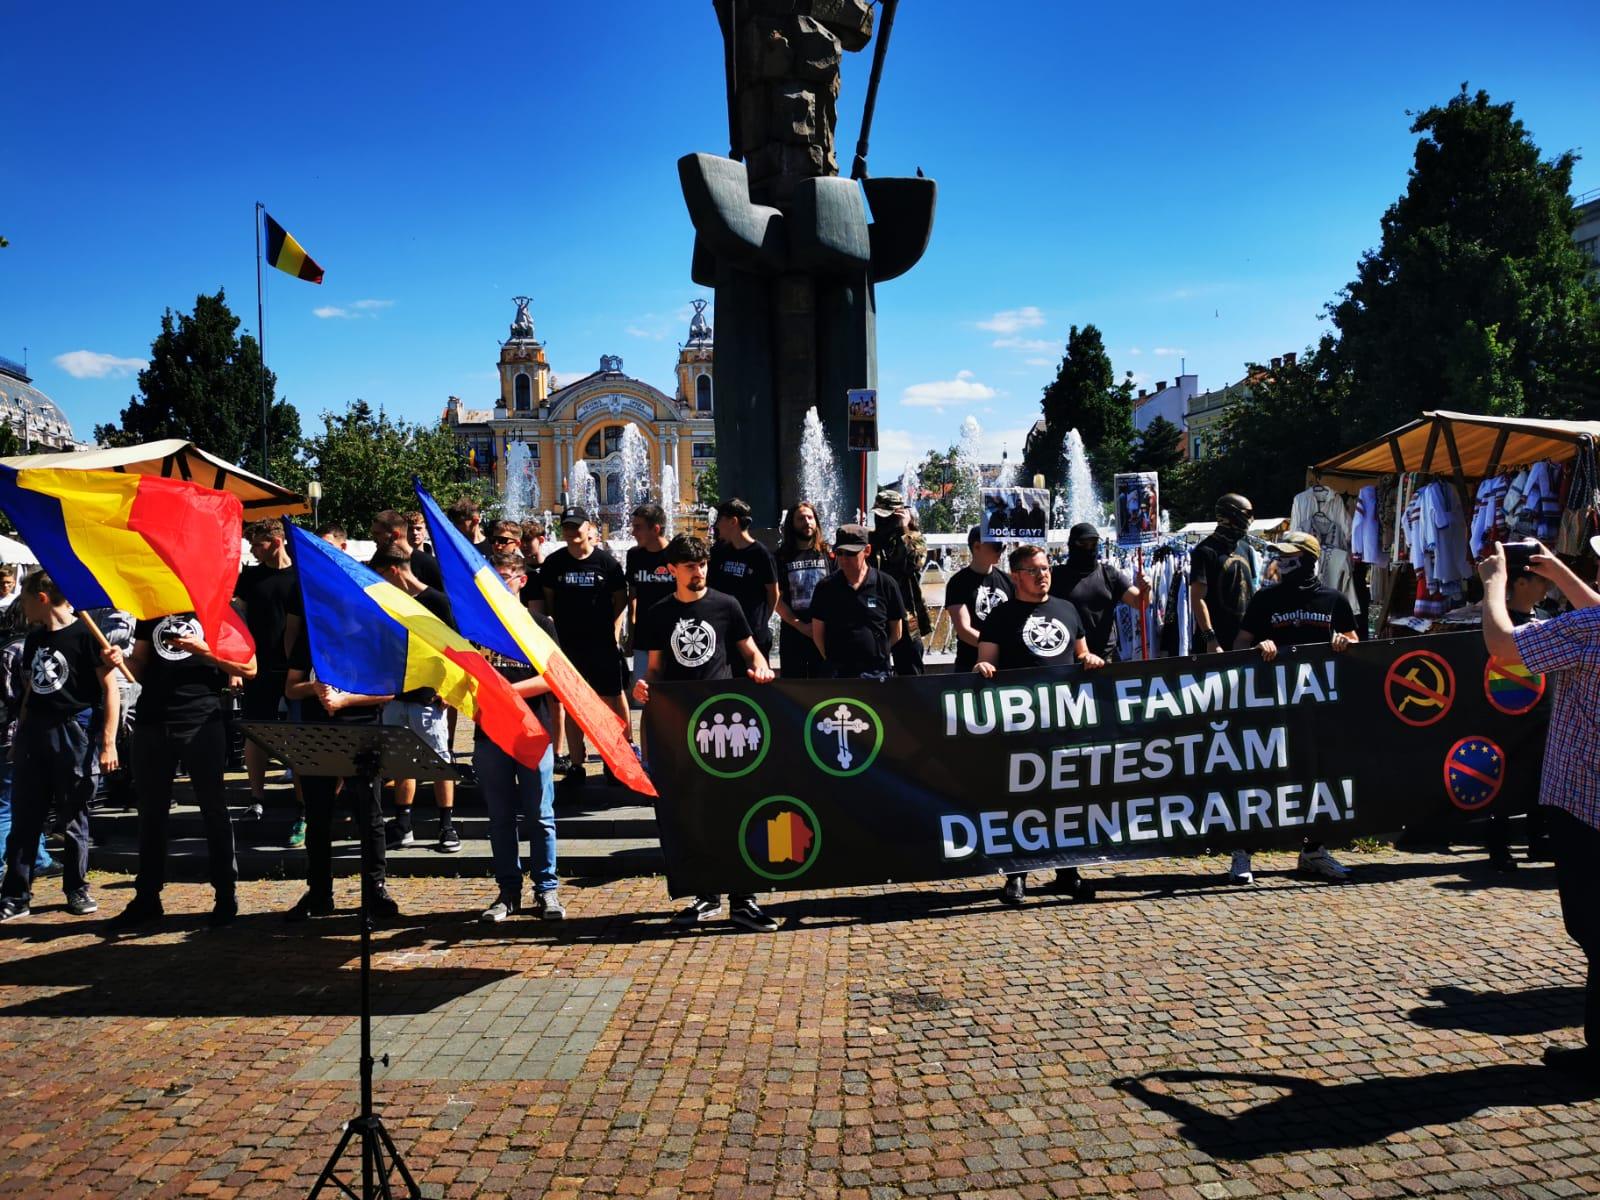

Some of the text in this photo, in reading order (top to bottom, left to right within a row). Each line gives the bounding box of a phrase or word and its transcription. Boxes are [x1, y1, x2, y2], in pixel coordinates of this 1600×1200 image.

[1019, 528, 1042, 536] GAY?
[944, 660, 1339, 737] IUBIM FAMILIA!
[1008, 719, 1288, 793] DETESTĂM
[940, 778, 1356, 860] DEGENERAREA!
